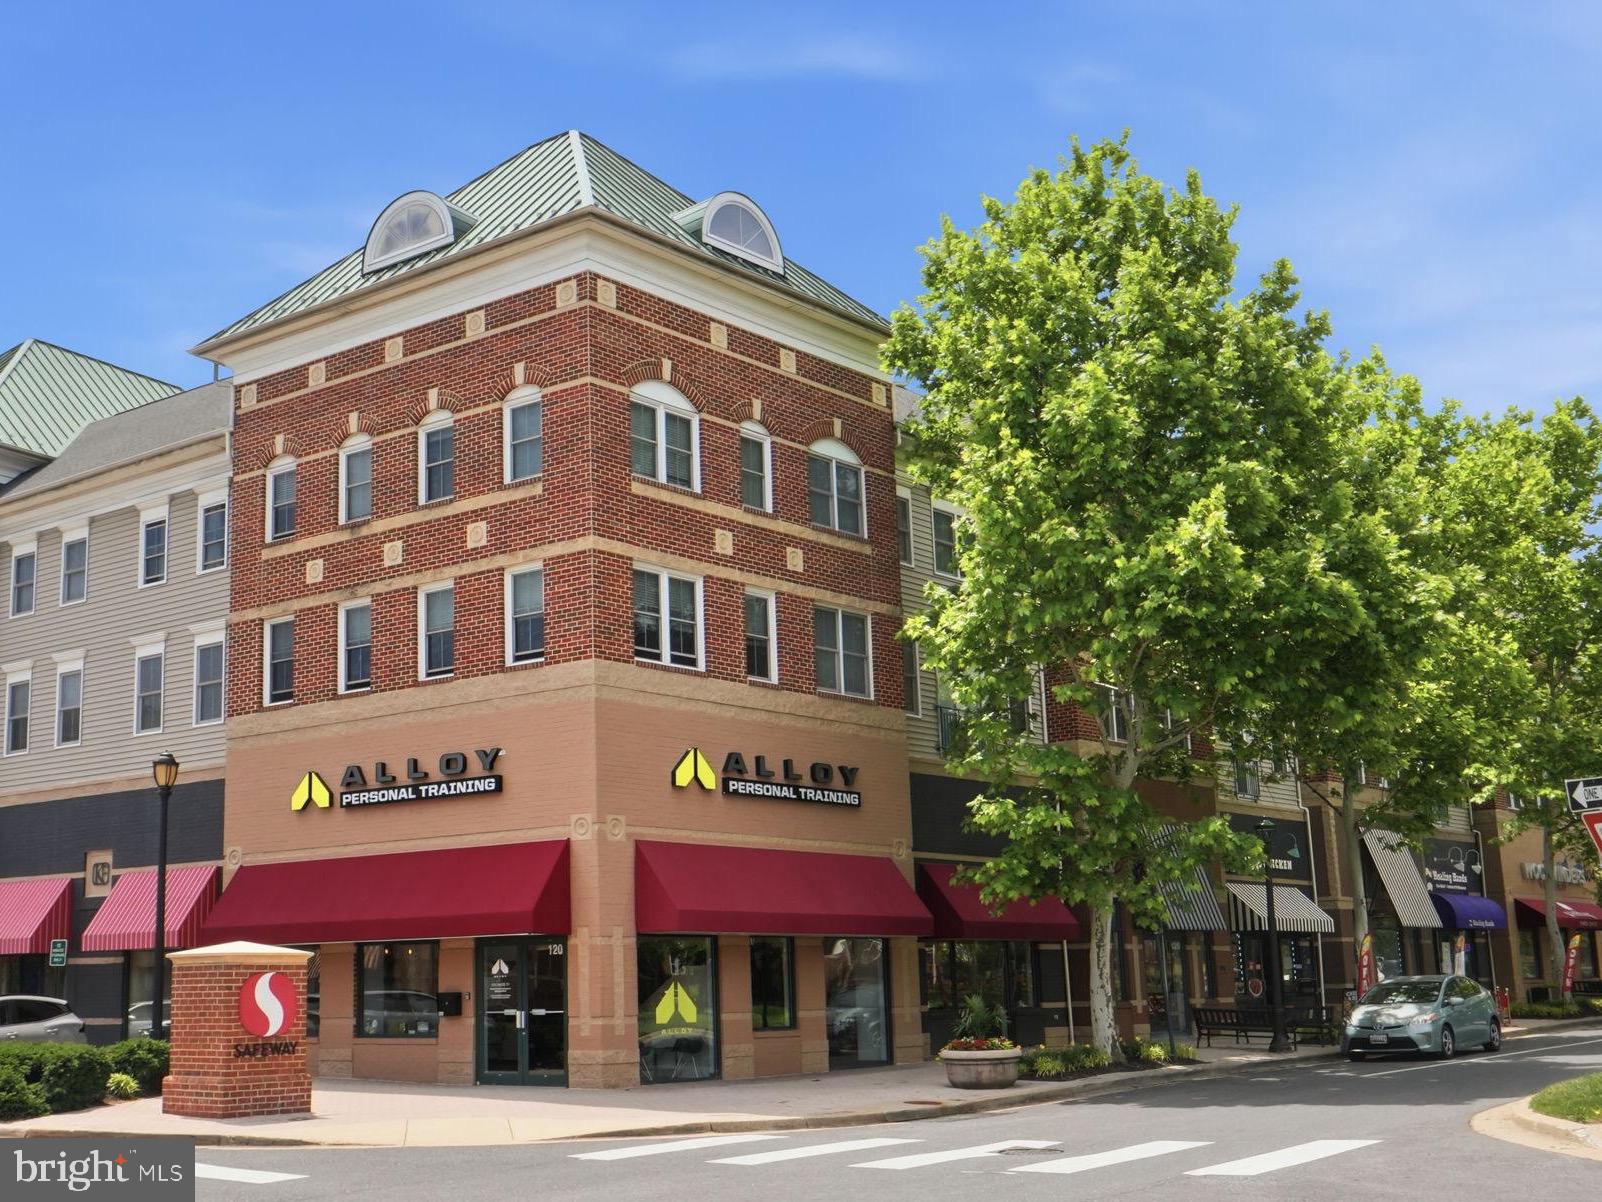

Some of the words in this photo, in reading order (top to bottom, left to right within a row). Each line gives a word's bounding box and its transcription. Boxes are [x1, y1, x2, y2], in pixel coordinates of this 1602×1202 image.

[341, 747, 502, 787] ALLOY
[722, 752, 860, 786] ALLOY
[342, 788, 416, 806] PERSONAL
[419, 778, 496, 798] TRAINING
[729, 780, 797, 799] PERSONAL
[799, 788, 859, 805] TRAINING
[1584, 787, 1600, 800] ONE
[548, 944, 563, 955] 120
[234, 1041, 298, 1058] SAFEWAY
